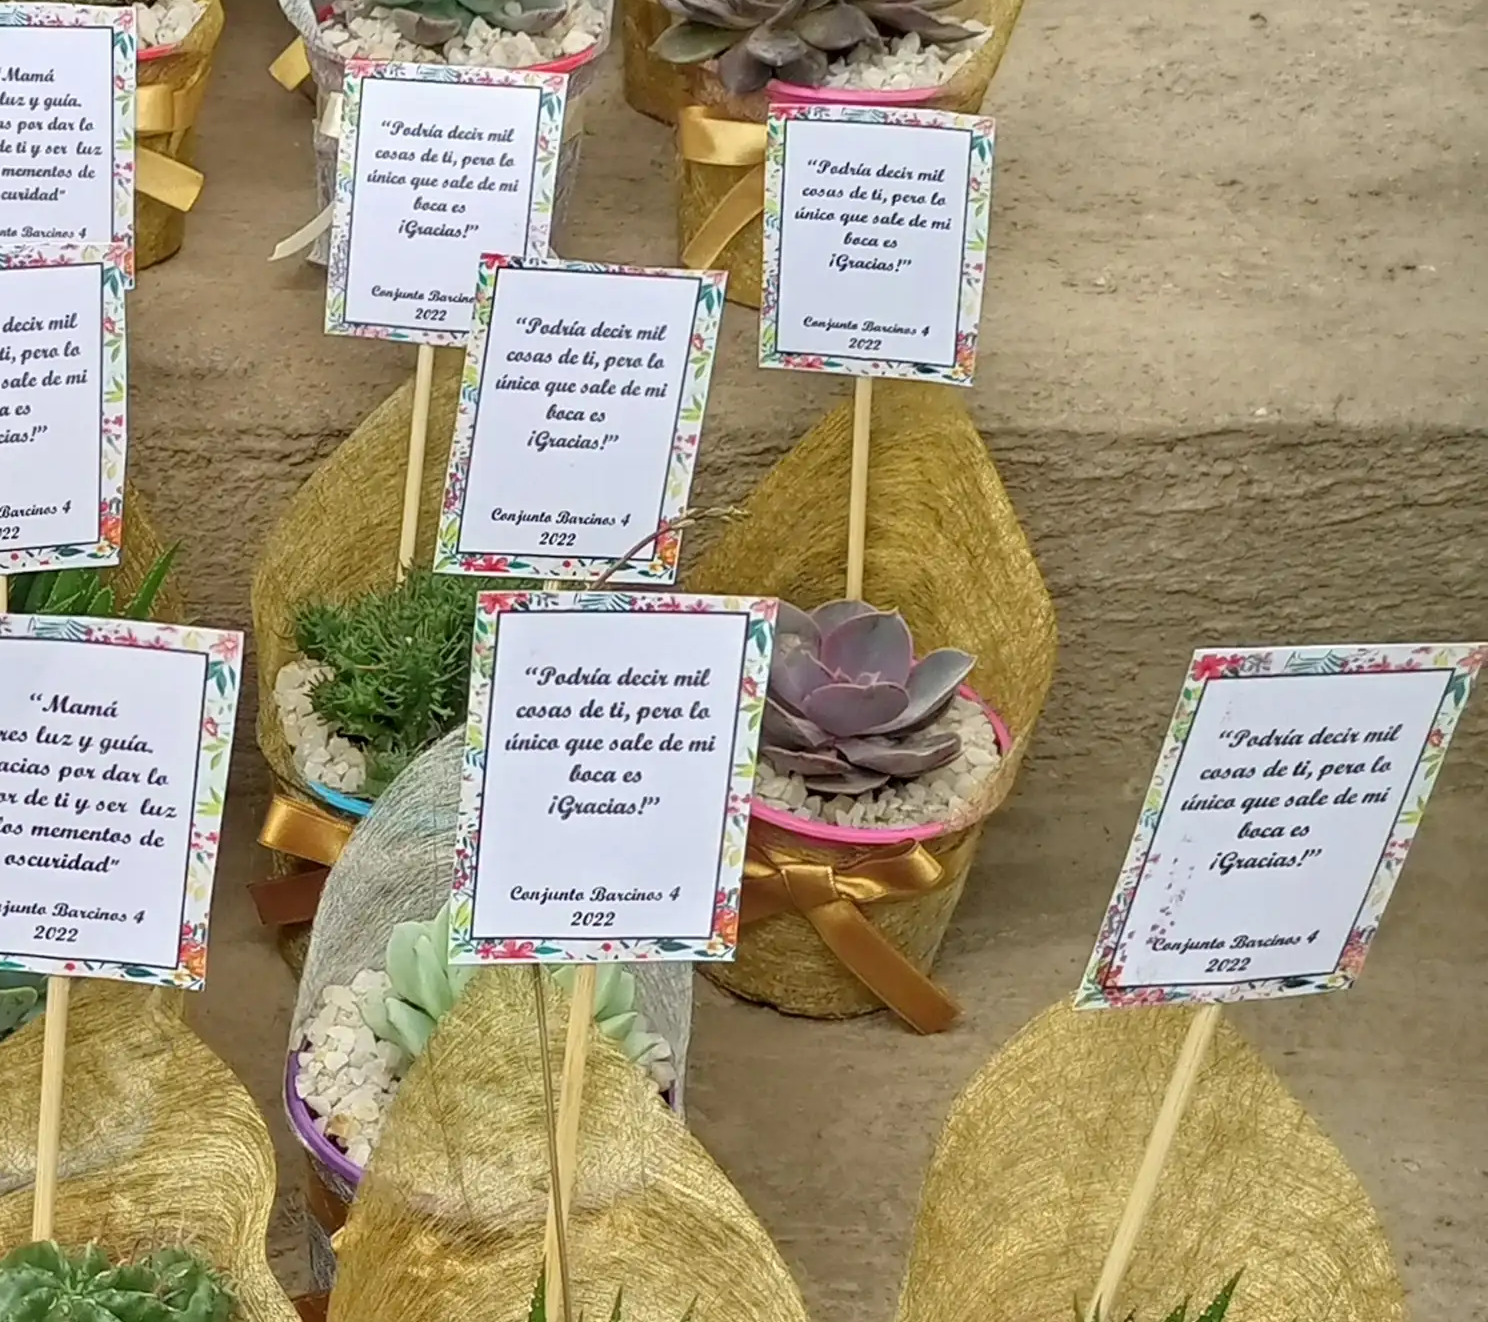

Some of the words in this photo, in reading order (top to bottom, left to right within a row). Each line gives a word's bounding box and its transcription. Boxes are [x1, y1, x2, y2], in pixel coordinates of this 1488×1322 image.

[35, 725, 73, 747] luz
[78, 735, 93, 754] y
[1307, 725, 1360, 745] decir
[1362, 723, 1403, 743] mil
[57, 765, 95, 783] por
[101, 763, 140, 784] dar
[146, 766, 168, 787] lo
[1199, 766, 1256, 781] cosas
[1261, 758, 1289, 778] de
[1291, 759, 1313, 780] ti,
[1315, 762, 1366, 782] pero
[1369, 754, 1392, 774] lo
[23, 787, 48, 807] de
[53, 791, 70, 808] ti
[74, 797, 89, 815] y
[95, 800, 127, 813] ser
[139, 797, 177, 818] luz
[1179, 793, 1236, 812] único
[1239, 796, 1281, 815] que
[1283, 787, 1329, 808] sale
[1332, 786, 1358, 805] de
[1360, 786, 1392, 804] mi
[139, 828, 164, 848] de
[1236, 820, 1285, 839] boca
[1289, 825, 1310, 838] es
[51, 902, 127, 923] Barcinos
[132, 909, 145, 924] 4
[32, 924, 79, 943] 2022
[1151, 936, 1226, 955] Conjunto
[1228, 934, 1302, 950] Barcinos
[1306, 929, 1320, 944] 4
[1204, 956, 1252, 973] 2022
